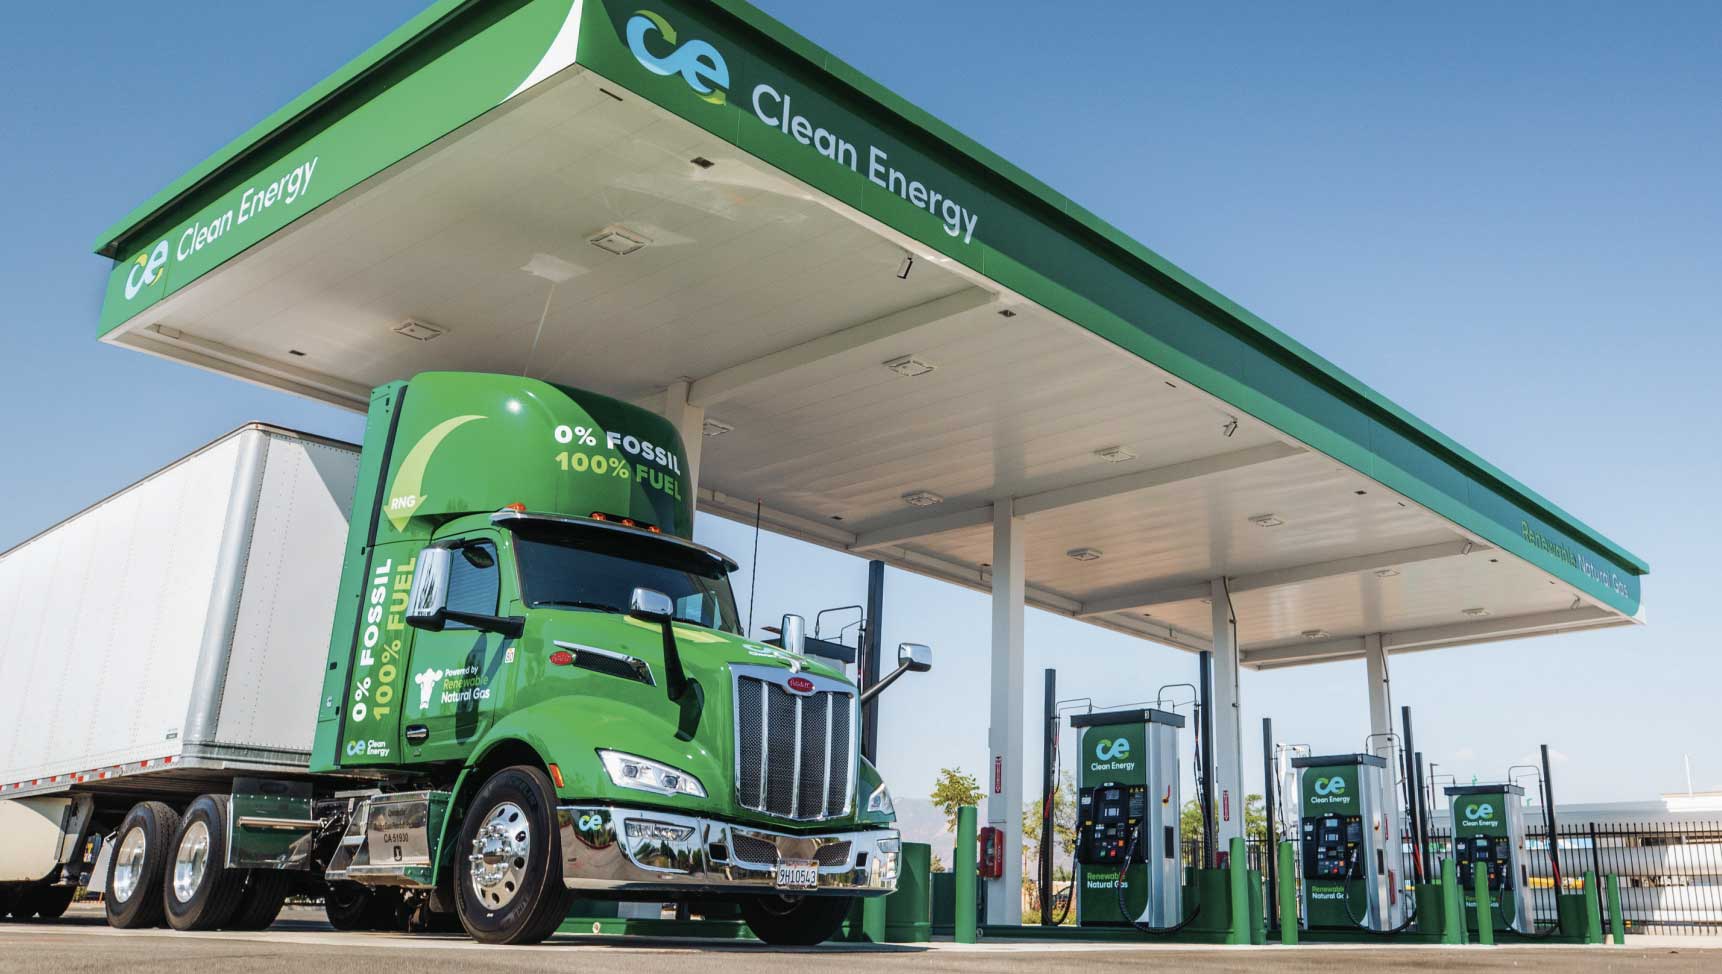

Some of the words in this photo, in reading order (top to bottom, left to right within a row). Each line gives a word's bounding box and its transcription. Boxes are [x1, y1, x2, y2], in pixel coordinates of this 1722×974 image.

[752, 84, 857, 172] Clean
[869, 145, 979, 244] Energy
[176, 209, 234, 262] Clean
[237, 156, 319, 225] Energy
[554, 424, 598, 449] 0%
[606, 430, 682, 476] FOSSIL
[555, 451, 629, 480] 100%
[635, 463, 682, 501] FUEL
[391, 495, 417, 511] RNG
[387, 556, 417, 630] FUEL
[1578, 554, 1612, 589] Natural
[1612, 574, 1629, 598] Gas
[360, 558, 393, 667] FOSSIL
[373, 639, 402, 721] 100%
[443, 675, 489, 690] Renewable
[445, 667, 470, 677] Powered
[471, 665, 479, 675] by
[352, 677, 372, 722] 0%
[441, 689, 472, 704] Natural
[473, 687, 491, 699] Gas
[367, 746, 390, 757] Energy
[368, 739, 386, 747] Clean
[1091, 763, 1111, 771] Clean
[1111, 761, 1135, 771] Energy
[1310, 796, 1329, 804] Clean
[1329, 795, 1350, 804] Energy
